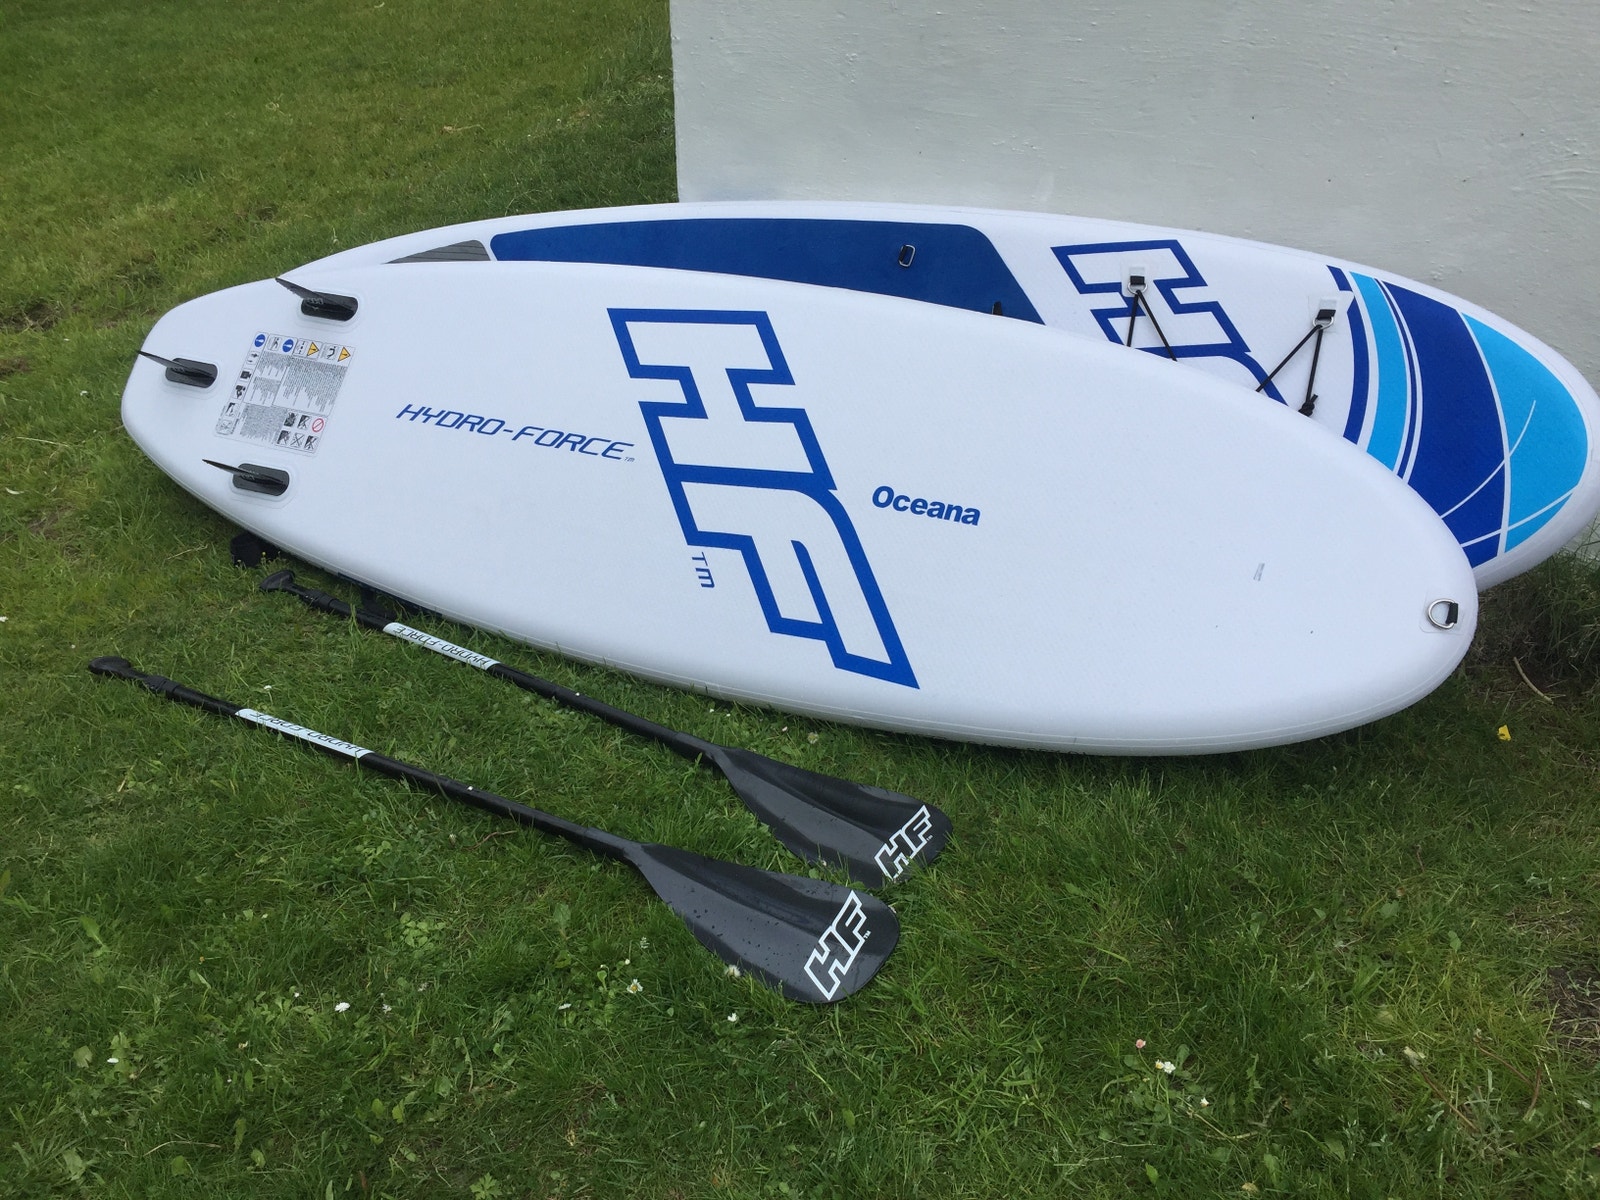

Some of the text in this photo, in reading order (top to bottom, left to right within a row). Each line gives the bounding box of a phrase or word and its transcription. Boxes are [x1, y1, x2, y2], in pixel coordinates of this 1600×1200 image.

[396, 403, 635, 460] HYDRO-FORCE
[872, 485, 981, 526] Oceana
[392, 625, 491, 666] HYDRO-FORCE
[874, 804, 932, 879] HF
[804, 889, 867, 1000] HF
